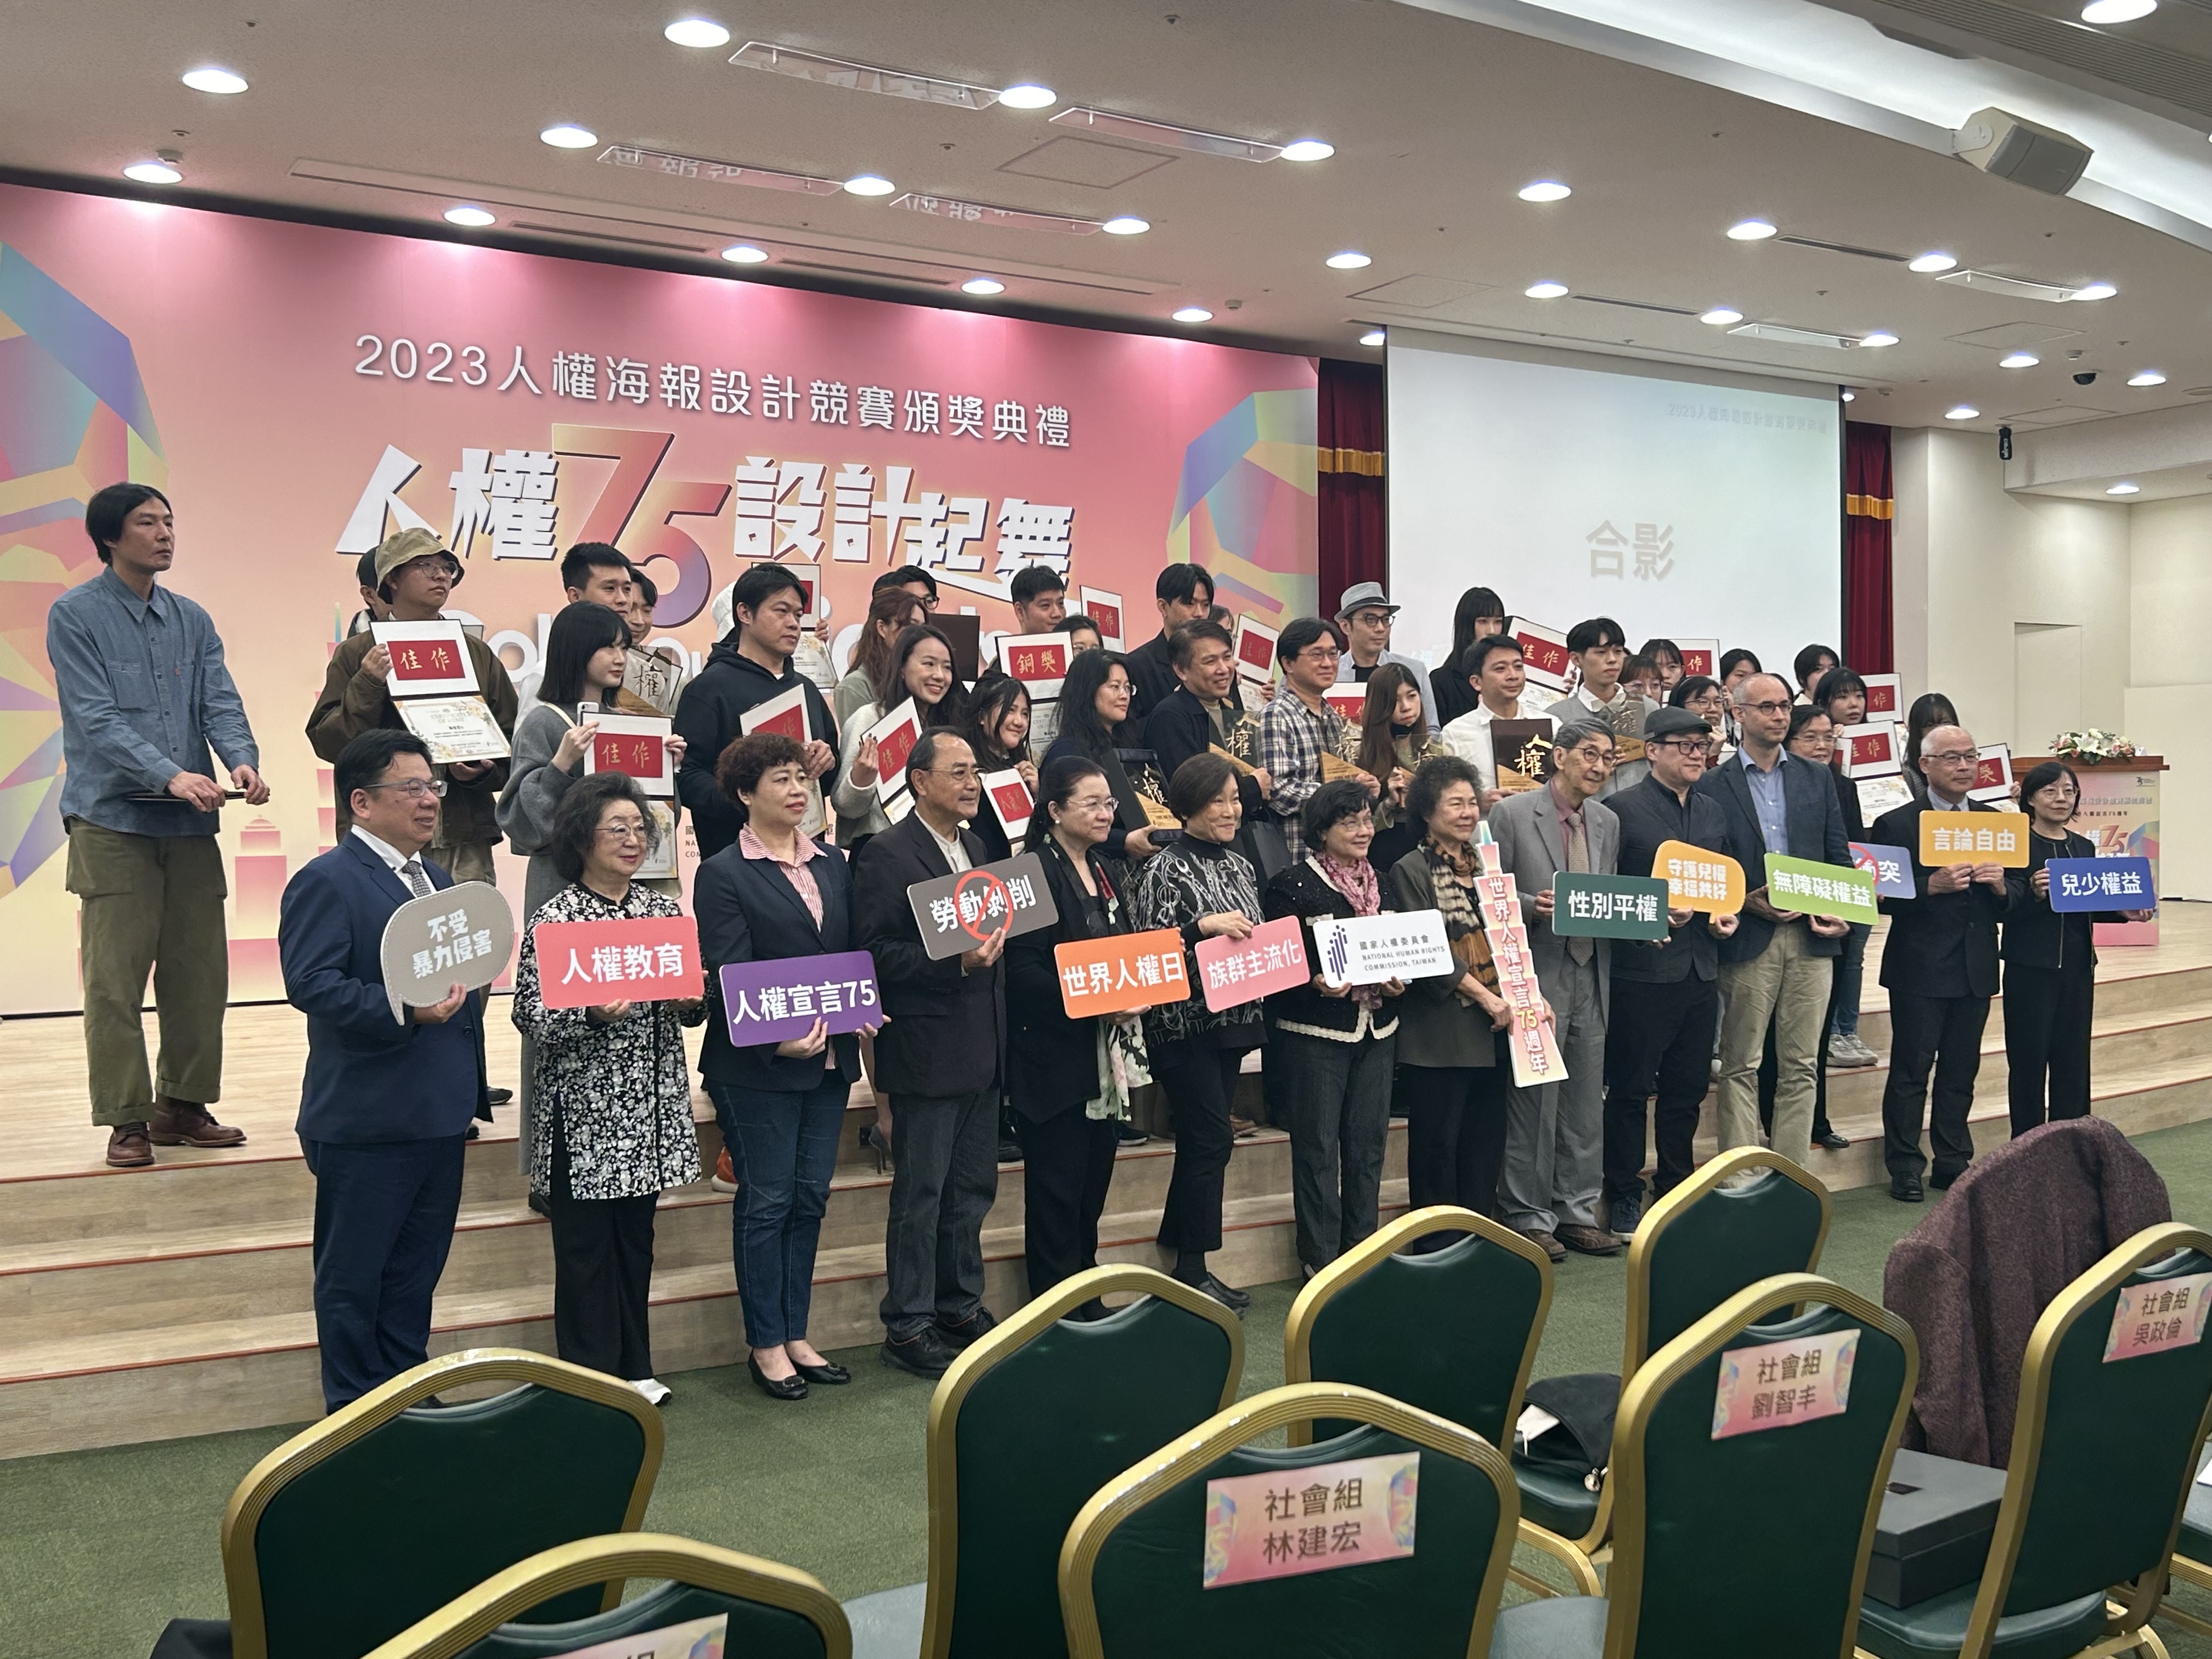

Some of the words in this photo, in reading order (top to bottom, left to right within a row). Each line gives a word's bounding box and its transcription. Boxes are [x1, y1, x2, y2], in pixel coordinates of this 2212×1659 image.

[354, 335, 1071, 448] 2023人權海報設計競賽頒獎典禮
[1585, 519, 1676, 582] 合影
[400, 646, 450, 673] 佳作
[1016, 650, 1057, 674] 銅獎
[1243, 640, 1267, 663] 佳作
[601, 742, 650, 769] 佳作
[1514, 733, 1553, 777] 人權
[1932, 827, 2016, 852] 言論自由
[929, 874, 1037, 933] 勞動剝削
[1773, 868, 1872, 908] 無障礙權益
[2061, 871, 2143, 897] 兒少權益
[427, 909, 467, 942] 不受
[1567, 890, 1658, 922] 性別平權
[413, 928, 492, 979] 暴力侵害
[1359, 934, 1429, 950] 國家人權委員會
[561, 942, 684, 985] 人權教育
[1063, 952, 1184, 997] 世界人權日
[1207, 939, 1302, 990] 族群主流化
[1488, 877, 1548, 1075] 世界人權宣言75週年
[732, 979, 876, 1025] 人權宣言75
[2142, 1287, 2190, 1316] 社會組
[1757, 1348, 1821, 1384] 社會組
[1265, 1477, 1363, 1521] 社會組
[1263, 1521, 1362, 1564] 林建宏
